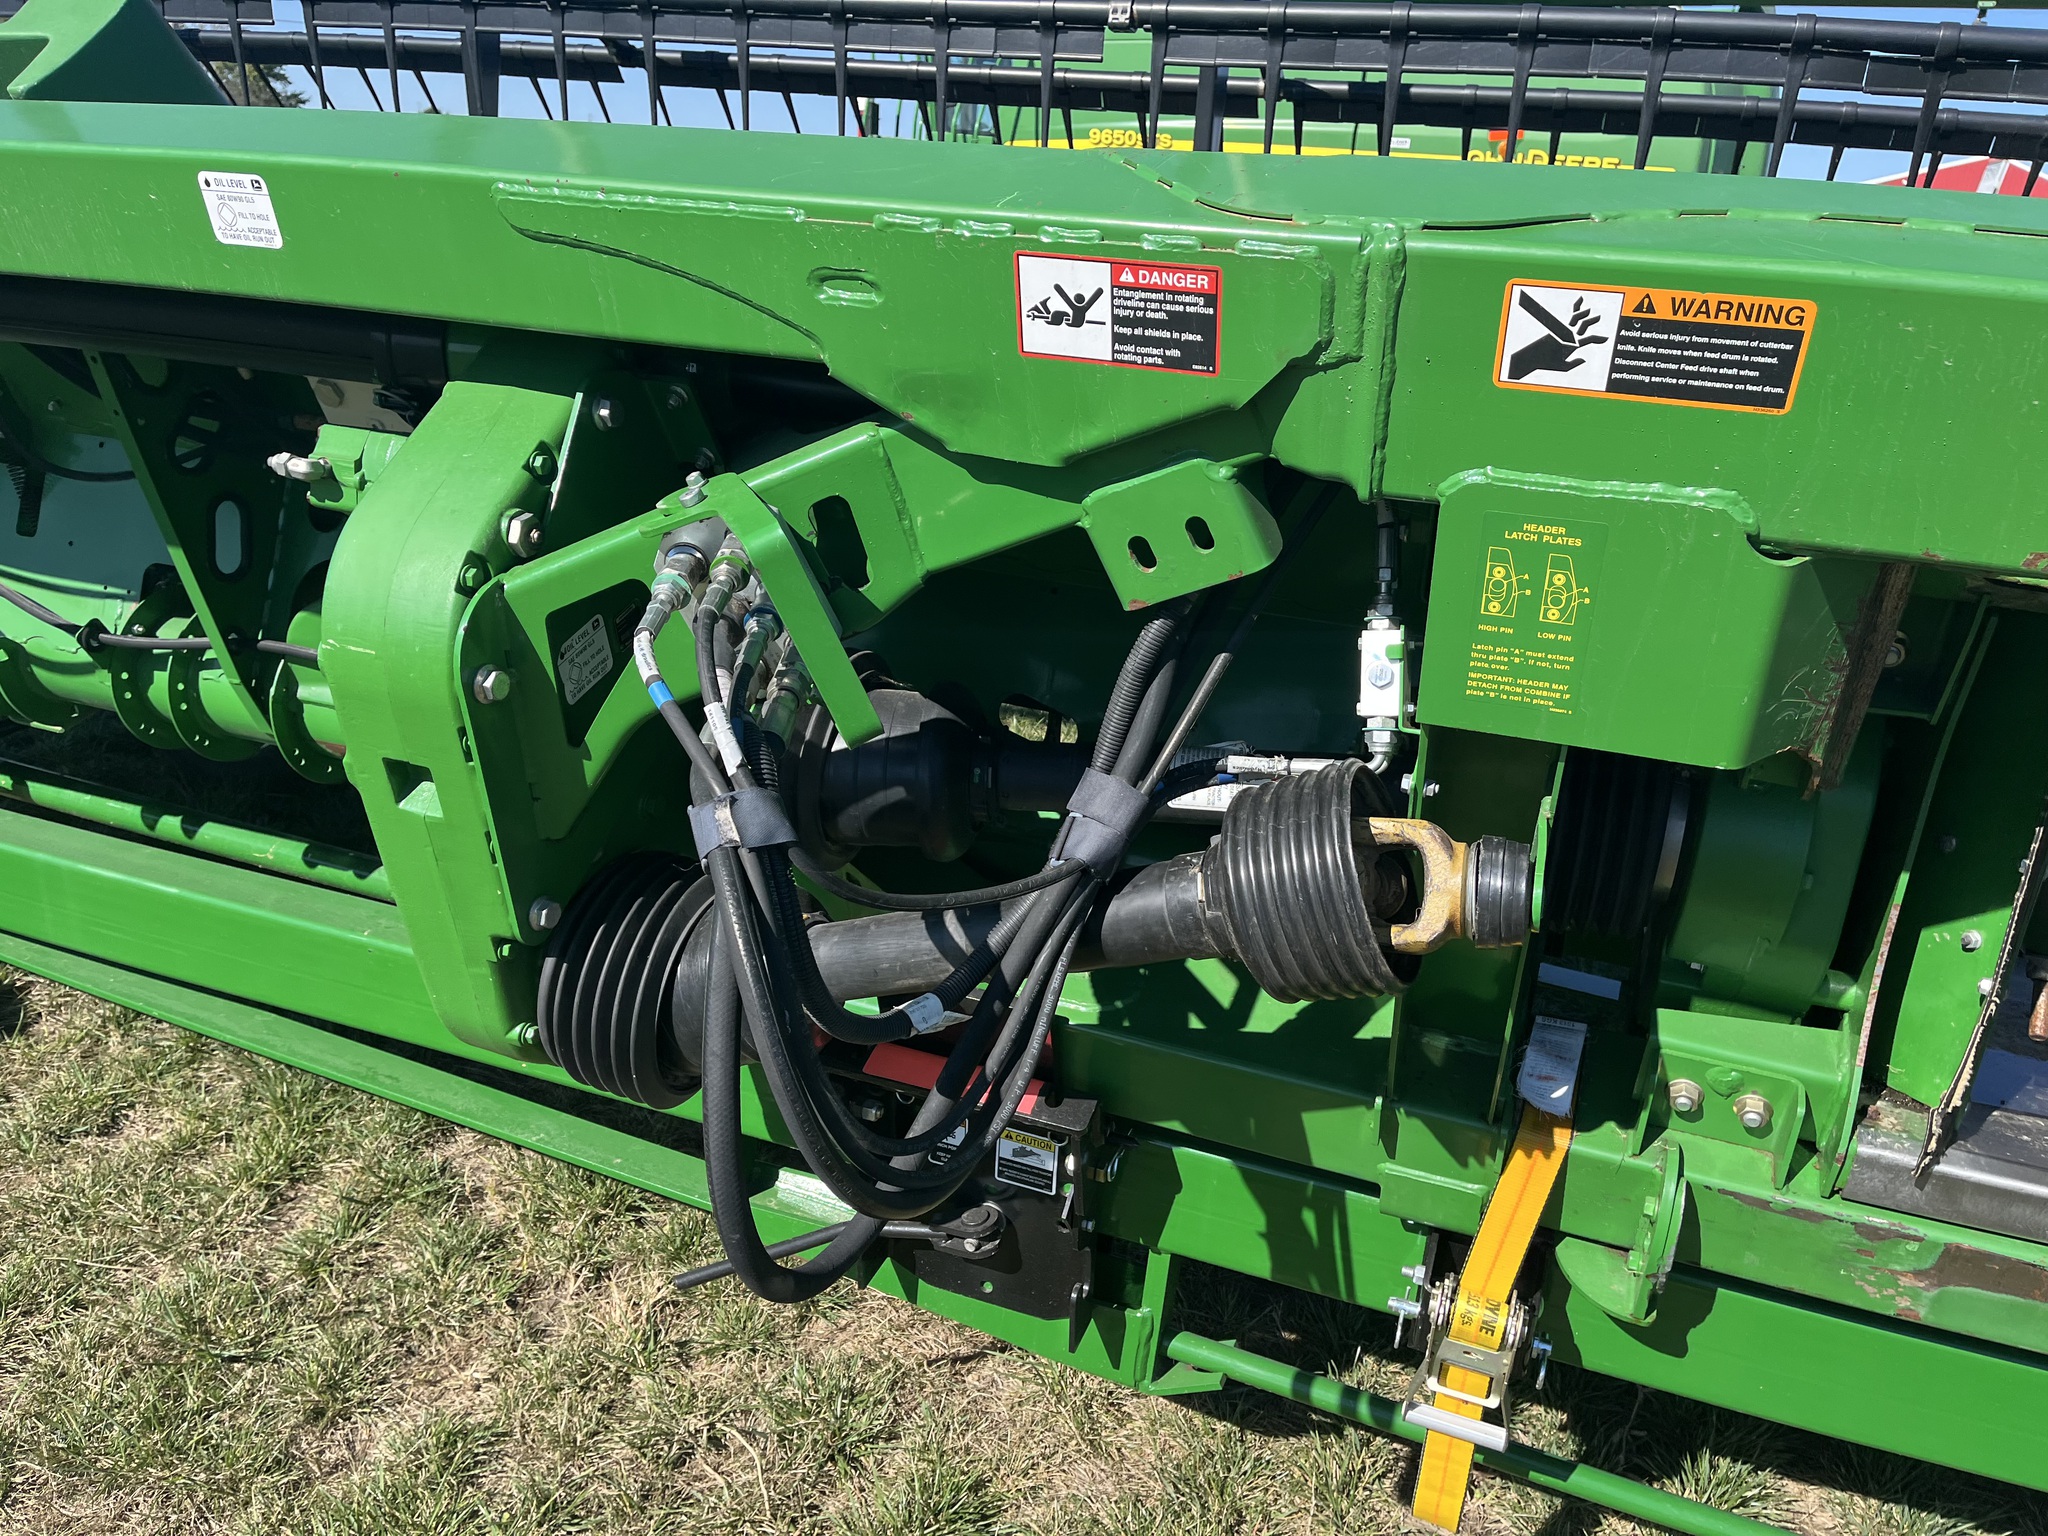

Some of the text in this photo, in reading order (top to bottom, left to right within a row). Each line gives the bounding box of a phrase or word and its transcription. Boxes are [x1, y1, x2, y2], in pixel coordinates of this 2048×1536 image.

[214, 178, 247, 188] OIL LEVEL
[247, 227, 277, 236] ACCEPTABLE
[1138, 270, 1209, 289] DANGER
[1113, 288, 1204, 305] Entanglement in rotating
[1113, 298, 1145, 308] driveline
[1162, 303, 1184, 312] cause
[1185, 304, 1214, 314] serious
[1113, 307, 1134, 318] injury
[1145, 309, 1168, 319] death.
[1671, 296, 1806, 327] WARNING
[1114, 325, 1204, 342] Keep all shields in place.
[1620, 330, 1794, 351] Avoid serious injury from movement of cutterbar
[1114, 343, 1181, 357] Avoid contact with
[1114, 352, 1164, 365] rotating parts.
[1617, 344, 1636, 353] knife.
[1638, 345, 1657, 354] Knife
[1658, 348, 1681, 356] moves
[1683, 349, 1702, 358] when
[1704, 350, 1720, 359] feed
[1721, 352, 1741, 361] drum
[1750, 354, 1779, 364] rotated.
[1614, 358, 1759, 377] Disconnect Center Feed drive shaft when
[1611, 373, 1785, 394] performing service or maintenance on feed drum.
[1523, 523, 1566, 535] HEADER
[1505, 531, 1582, 547] LATCH PLATES
[1478, 624, 1498, 632] HIGH
[574, 629, 590, 645] LEVEL
[1537, 632, 1572, 642] LOW PIN
[1471, 651, 1487, 660] thru
[1489, 654, 1508, 663] plate
[1538, 660, 1552, 669] not,
[1554, 662, 1570, 670] turn
[1472, 643, 1493, 652] Latch
[1496, 646, 1508, 654] pin
[1526, 650, 1545, 658] must
[1547, 653, 1574, 662] extend
[1467, 680, 1497, 690] DETACH
[1499, 685, 1522, 694] FROM
[1524, 688, 1561, 698] COMBINE
[1468, 672, 1569, 691] IMPORTANT: HEADER MAY
[1466, 689, 1484, 698] plate
[1533, 698, 1555, 707] place.
[1001, 1102, 1016, 1119] 3000
[992, 1120, 1004, 1137] PSI
[1015, 1134, 1052, 1150] CAUTION
